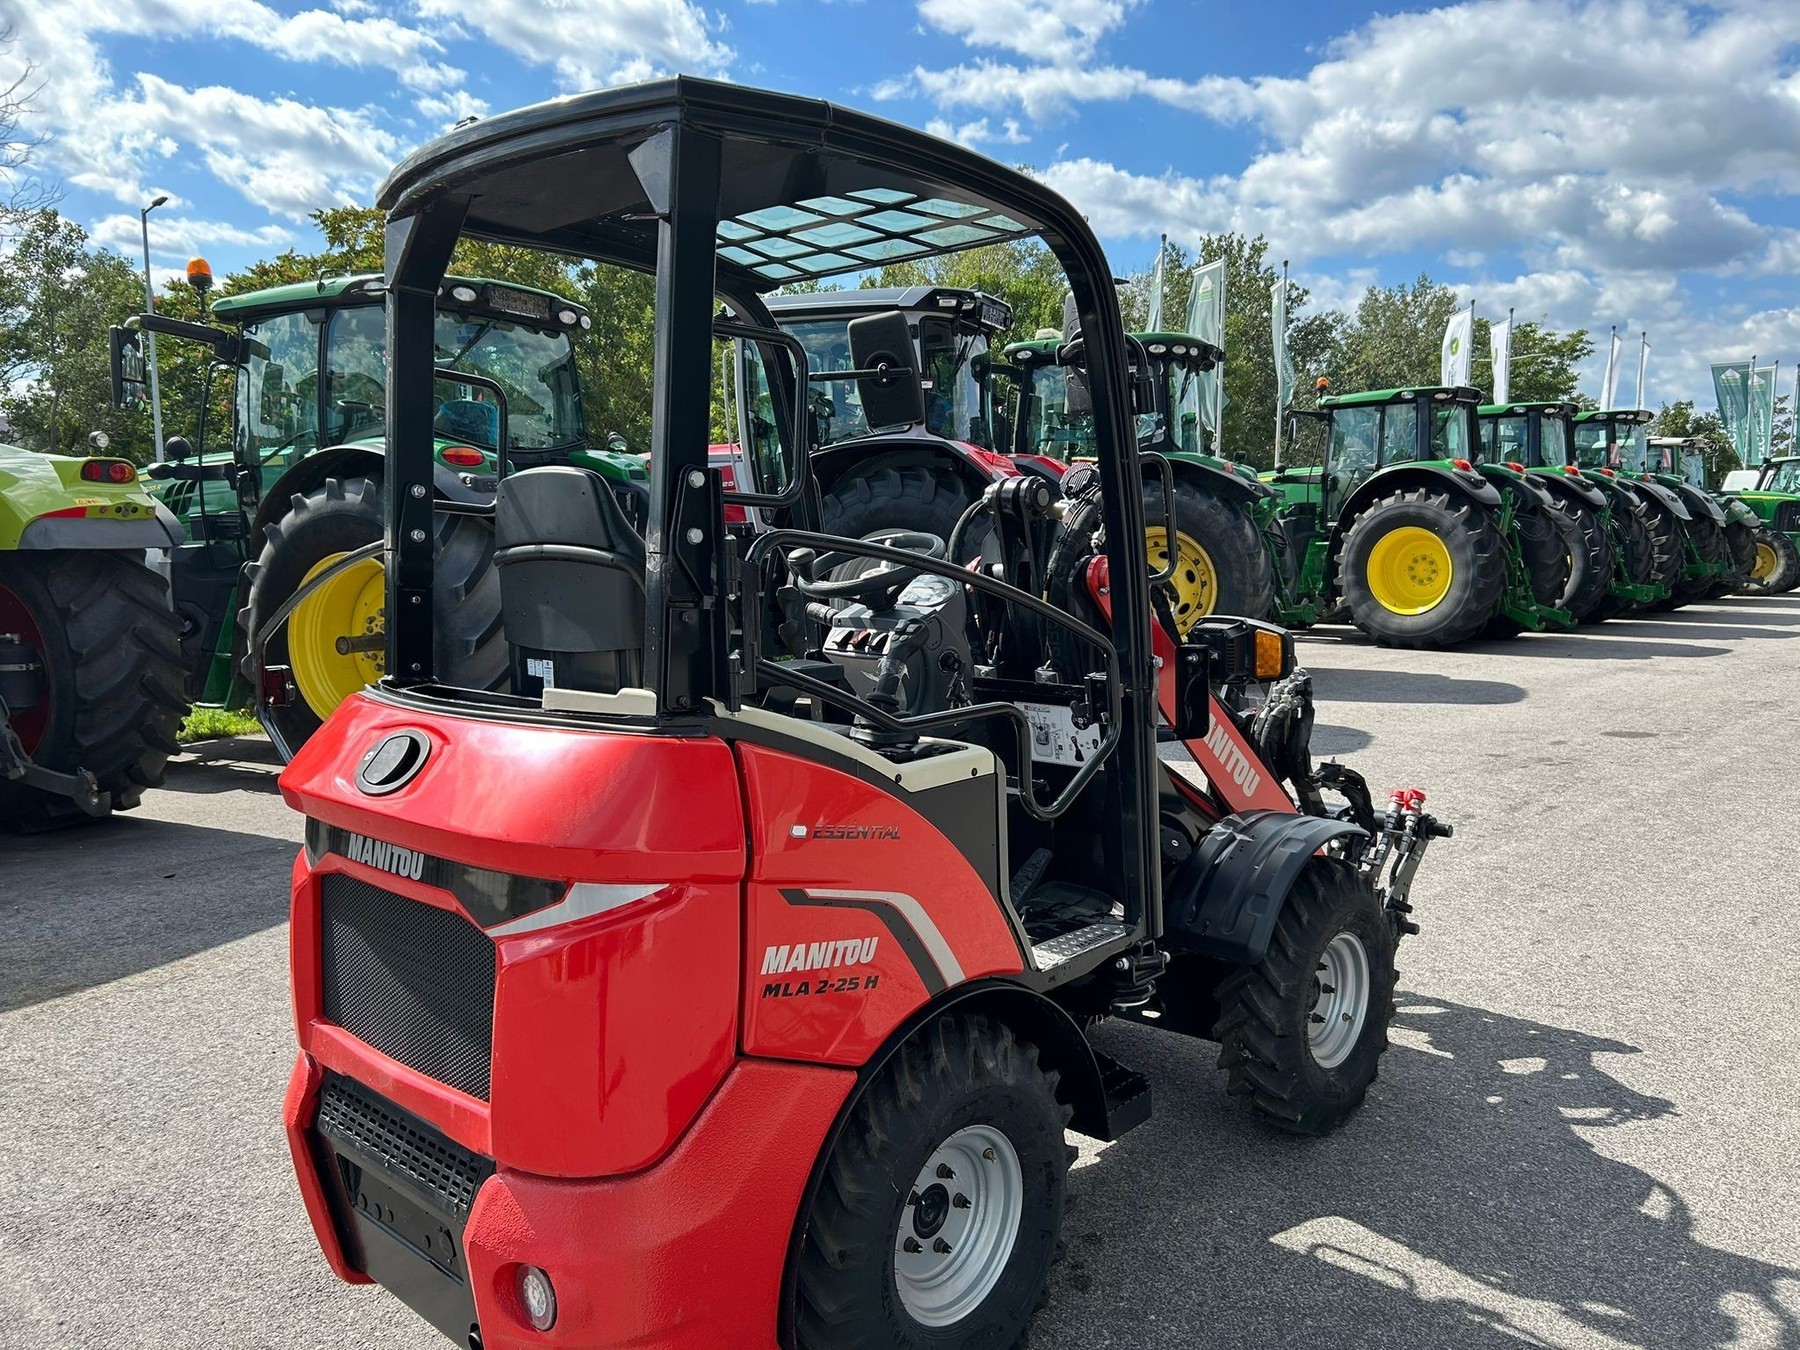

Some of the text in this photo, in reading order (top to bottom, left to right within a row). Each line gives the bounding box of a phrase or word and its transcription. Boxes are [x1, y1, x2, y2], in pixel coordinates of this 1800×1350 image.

[812, 824, 901, 840] ESSENTIAL
[347, 832, 425, 881] MANITOU
[760, 936, 879, 976] MANITOU
[762, 975, 880, 999] MLA 2-25 H
